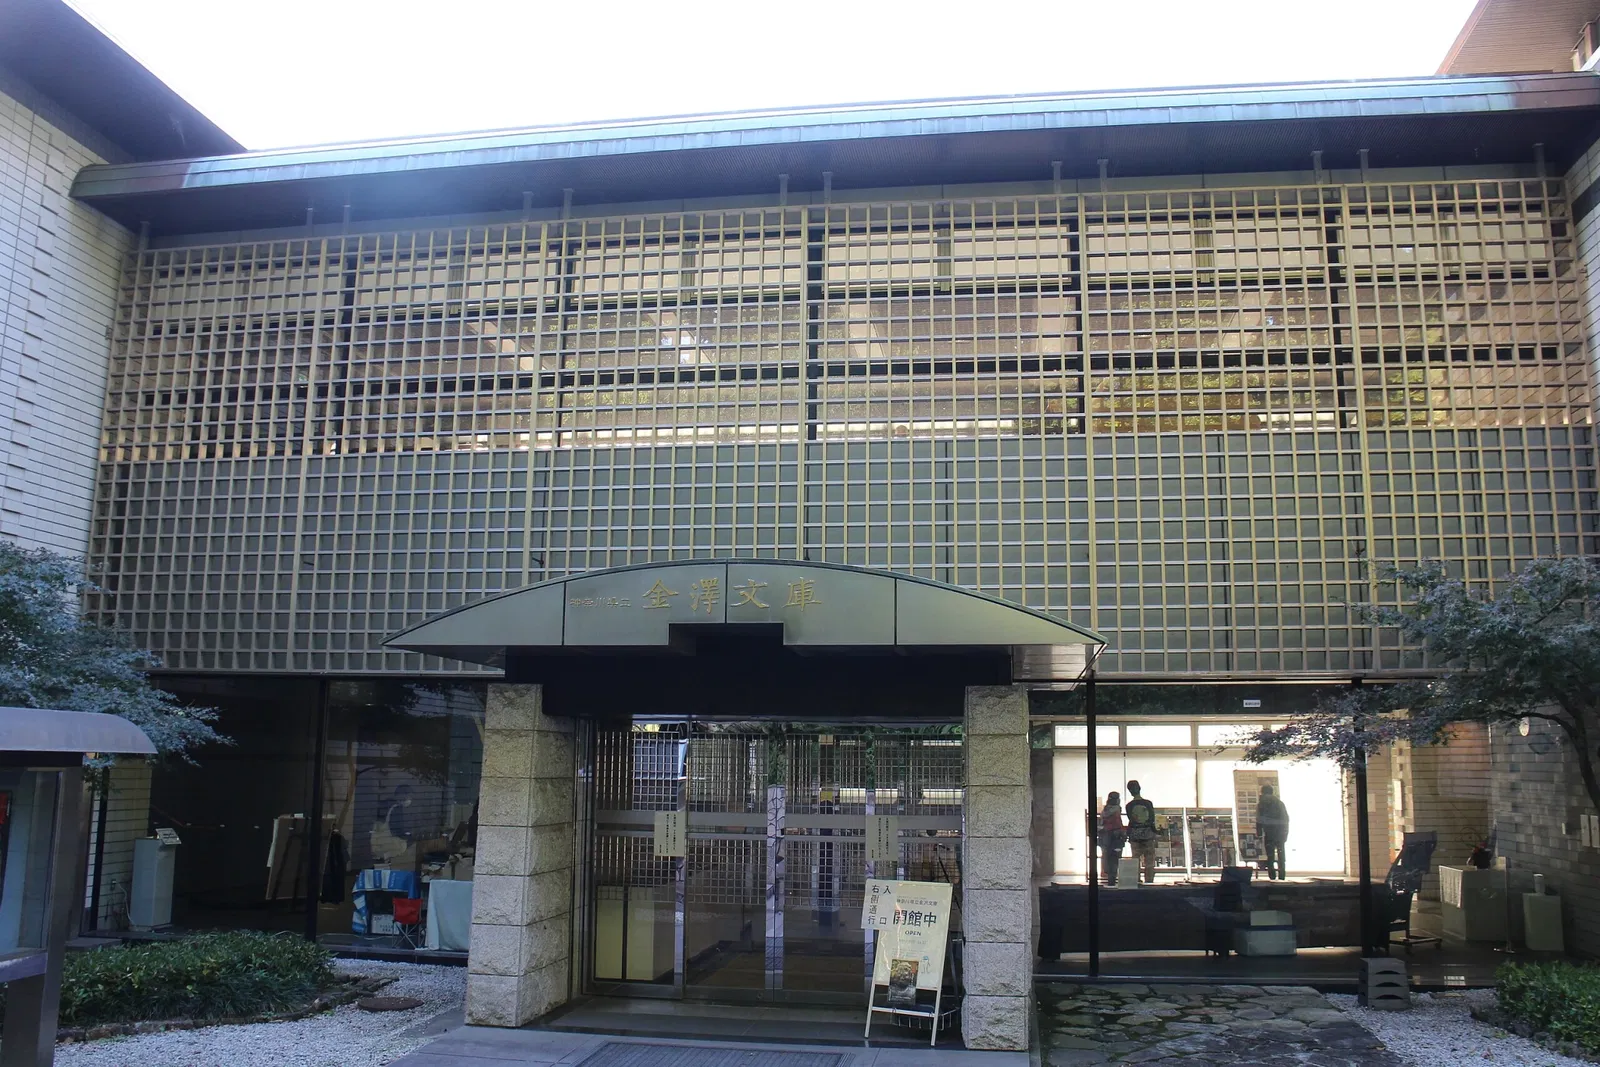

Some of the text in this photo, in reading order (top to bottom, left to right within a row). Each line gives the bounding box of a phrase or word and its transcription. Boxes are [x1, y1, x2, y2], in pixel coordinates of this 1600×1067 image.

[642, 577, 822, 615] 金澤文庫
[868, 885, 879, 925] 右側通行
[893, 910, 937, 928] 開館中
